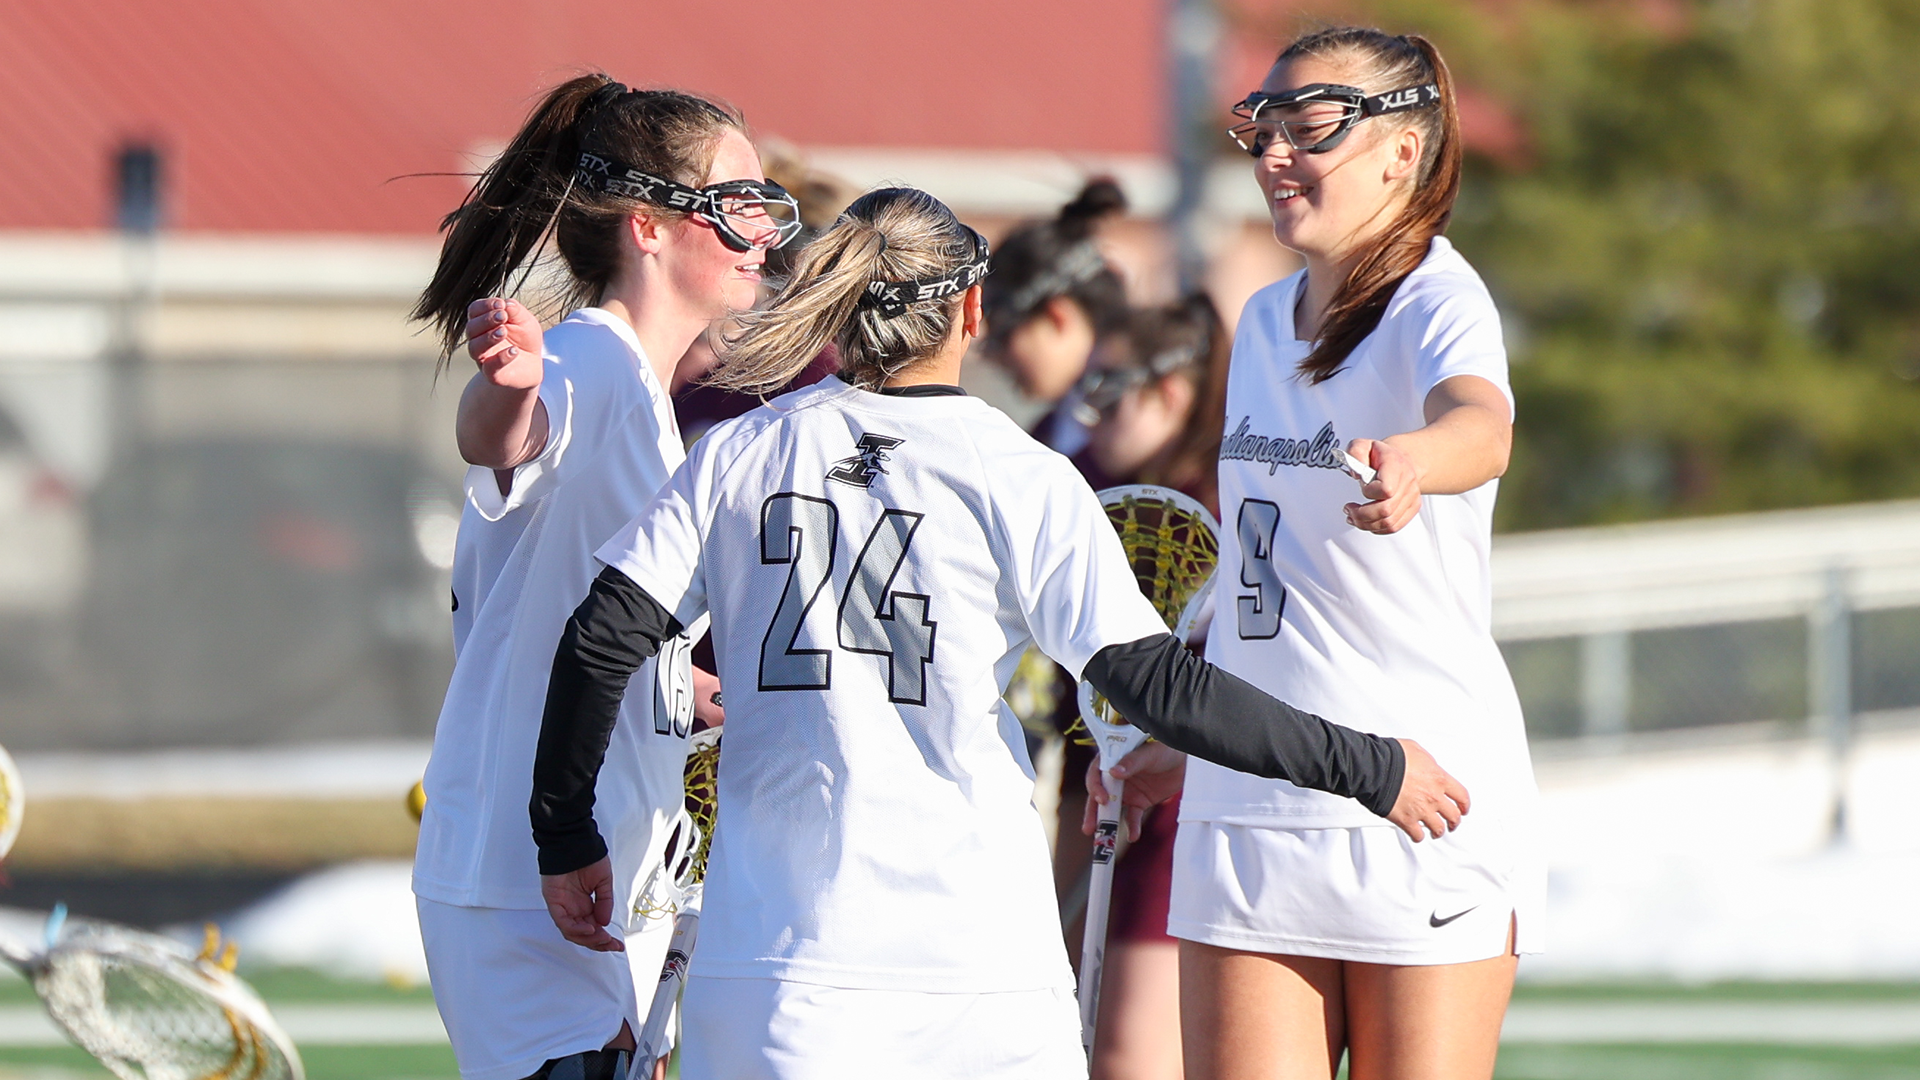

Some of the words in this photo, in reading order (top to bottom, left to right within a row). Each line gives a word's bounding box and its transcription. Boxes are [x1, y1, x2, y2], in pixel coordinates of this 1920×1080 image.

[579, 152, 612, 176] STX
[604, 178, 655, 200] STX
[668, 190, 709, 211] ST
[916, 276, 960, 300] STX
[967, 259, 989, 286] STX
[1219, 415, 1343, 476] ndianapolis
[1237, 497, 1287, 641] 9
[757, 491, 937, 707] 24
